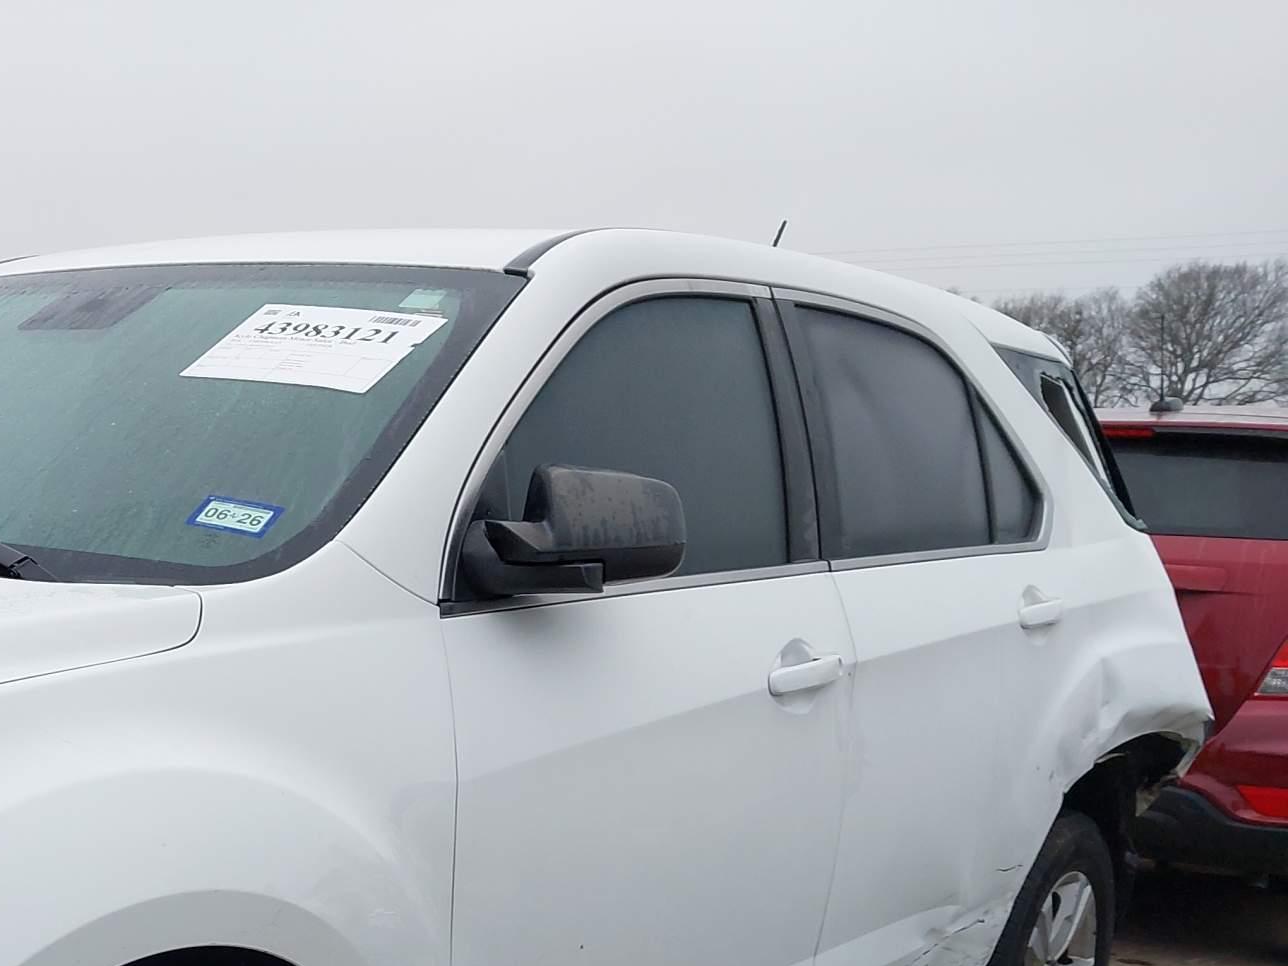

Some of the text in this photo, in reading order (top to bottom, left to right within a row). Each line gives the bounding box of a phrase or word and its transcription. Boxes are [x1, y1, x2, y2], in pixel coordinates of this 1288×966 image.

[253, 321, 399, 345] 43983121
[203, 507, 265, 527] 06 26
